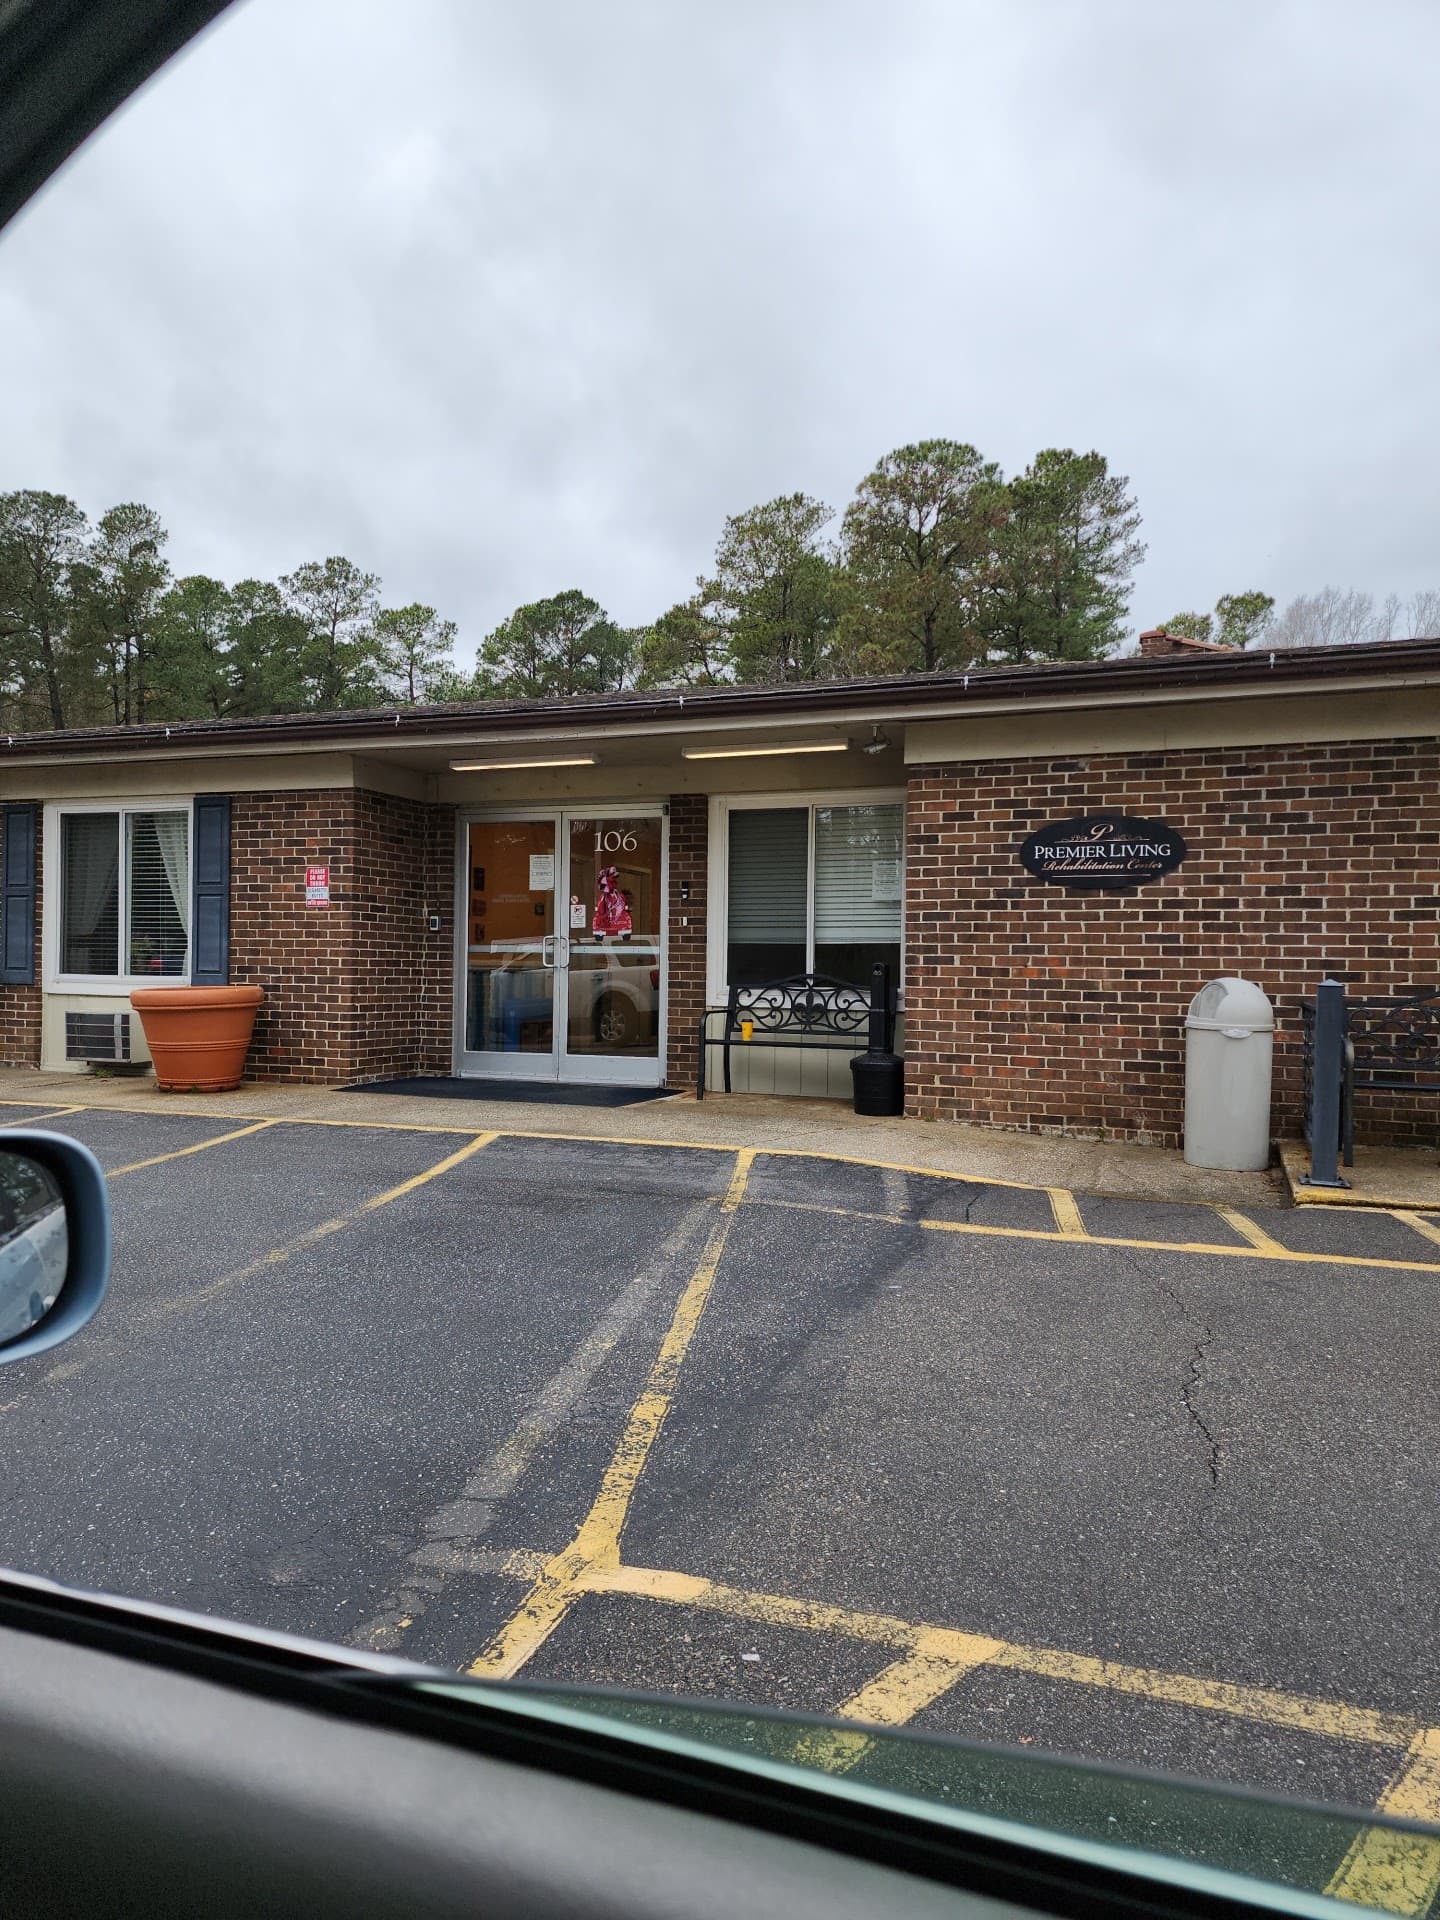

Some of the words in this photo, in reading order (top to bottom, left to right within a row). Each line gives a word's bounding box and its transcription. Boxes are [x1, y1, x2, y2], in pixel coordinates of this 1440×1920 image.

[594, 830, 637, 852] 106
[1034, 845, 1108, 859] PREMIER
[1109, 843, 1171, 858] LIVING
[1042, 857, 1125, 871] Rehabilitation
[1127, 858, 1163, 870] Center
